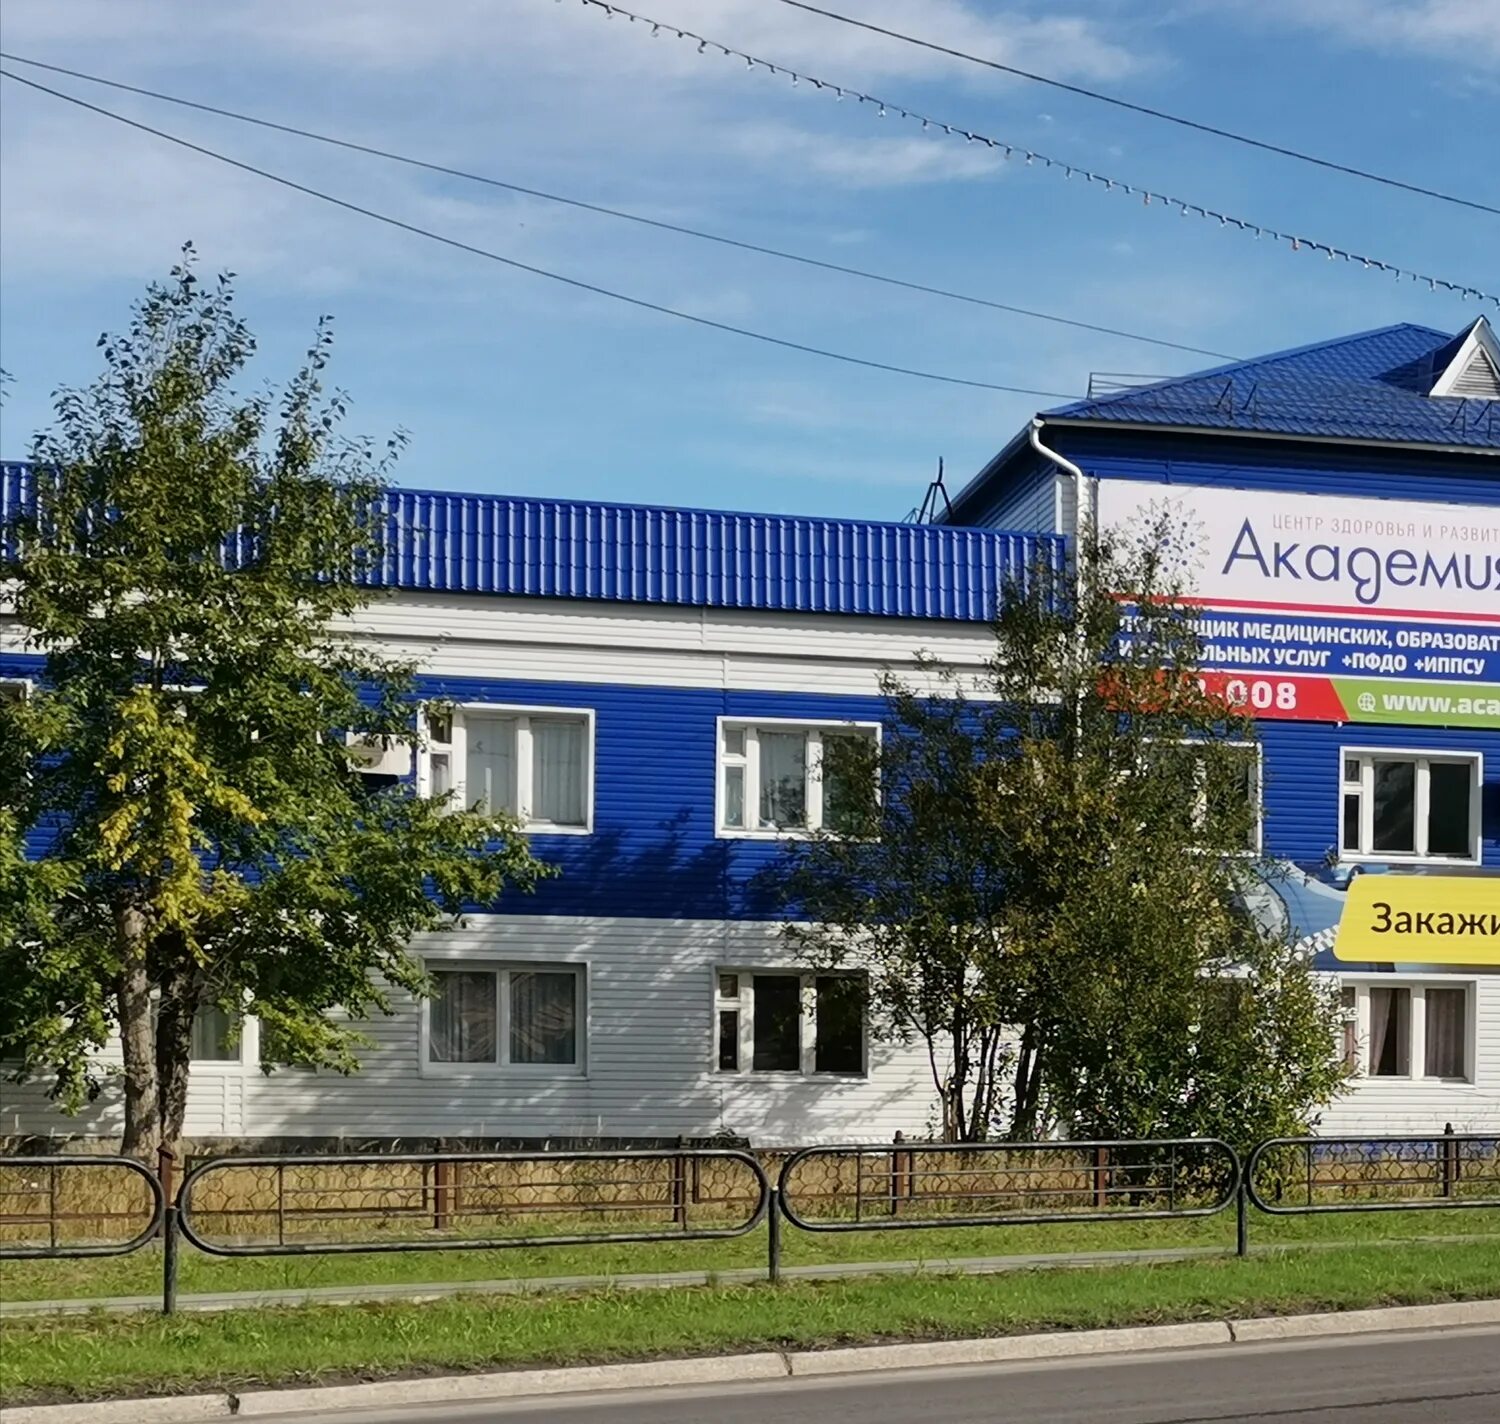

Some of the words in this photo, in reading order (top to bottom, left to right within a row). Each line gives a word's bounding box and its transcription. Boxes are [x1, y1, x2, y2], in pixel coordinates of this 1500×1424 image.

[1272, 513, 1324, 531] ЦЕНТР
[1331, 518, 1416, 537] ЗДОРОВЬЯ
[1423, 524, 1433, 538] И
[1242, 622, 1393, 649] МЕДИЦИНСКИХ,
[1274, 648, 1331, 667] УСЛУГ
[1342, 652, 1407, 673] +ПФДО
[1414, 656, 1485, 675] +ИППСУ
